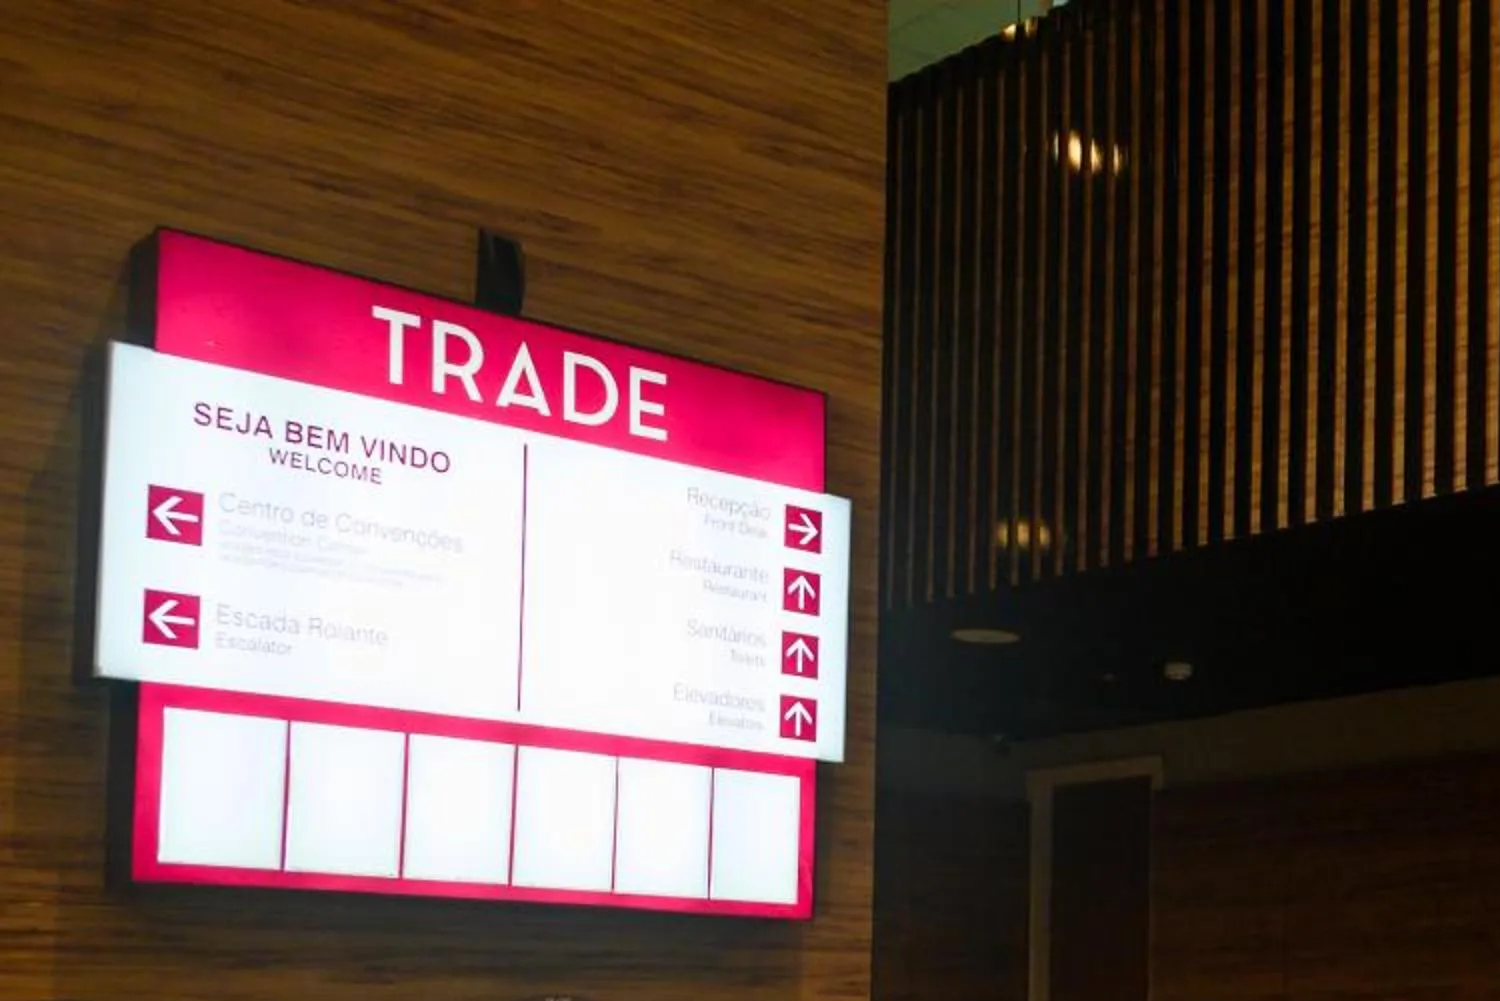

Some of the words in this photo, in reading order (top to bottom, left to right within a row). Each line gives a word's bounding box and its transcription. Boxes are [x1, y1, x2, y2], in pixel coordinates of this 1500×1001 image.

[372, 305, 668, 442] TRADE
[193, 402, 273, 439] SEJA
[285, 421, 350, 454] BEM
[361, 435, 452, 474] VINDO
[268, 448, 383, 485] WELCOME
[218, 492, 295, 524] Centro
[301, 510, 329, 529] de
[335, 512, 464, 553] Convenções
[215, 632, 293, 655] Escalator
[216, 602, 300, 635] Escada
[308, 616, 389, 647] Rolante
